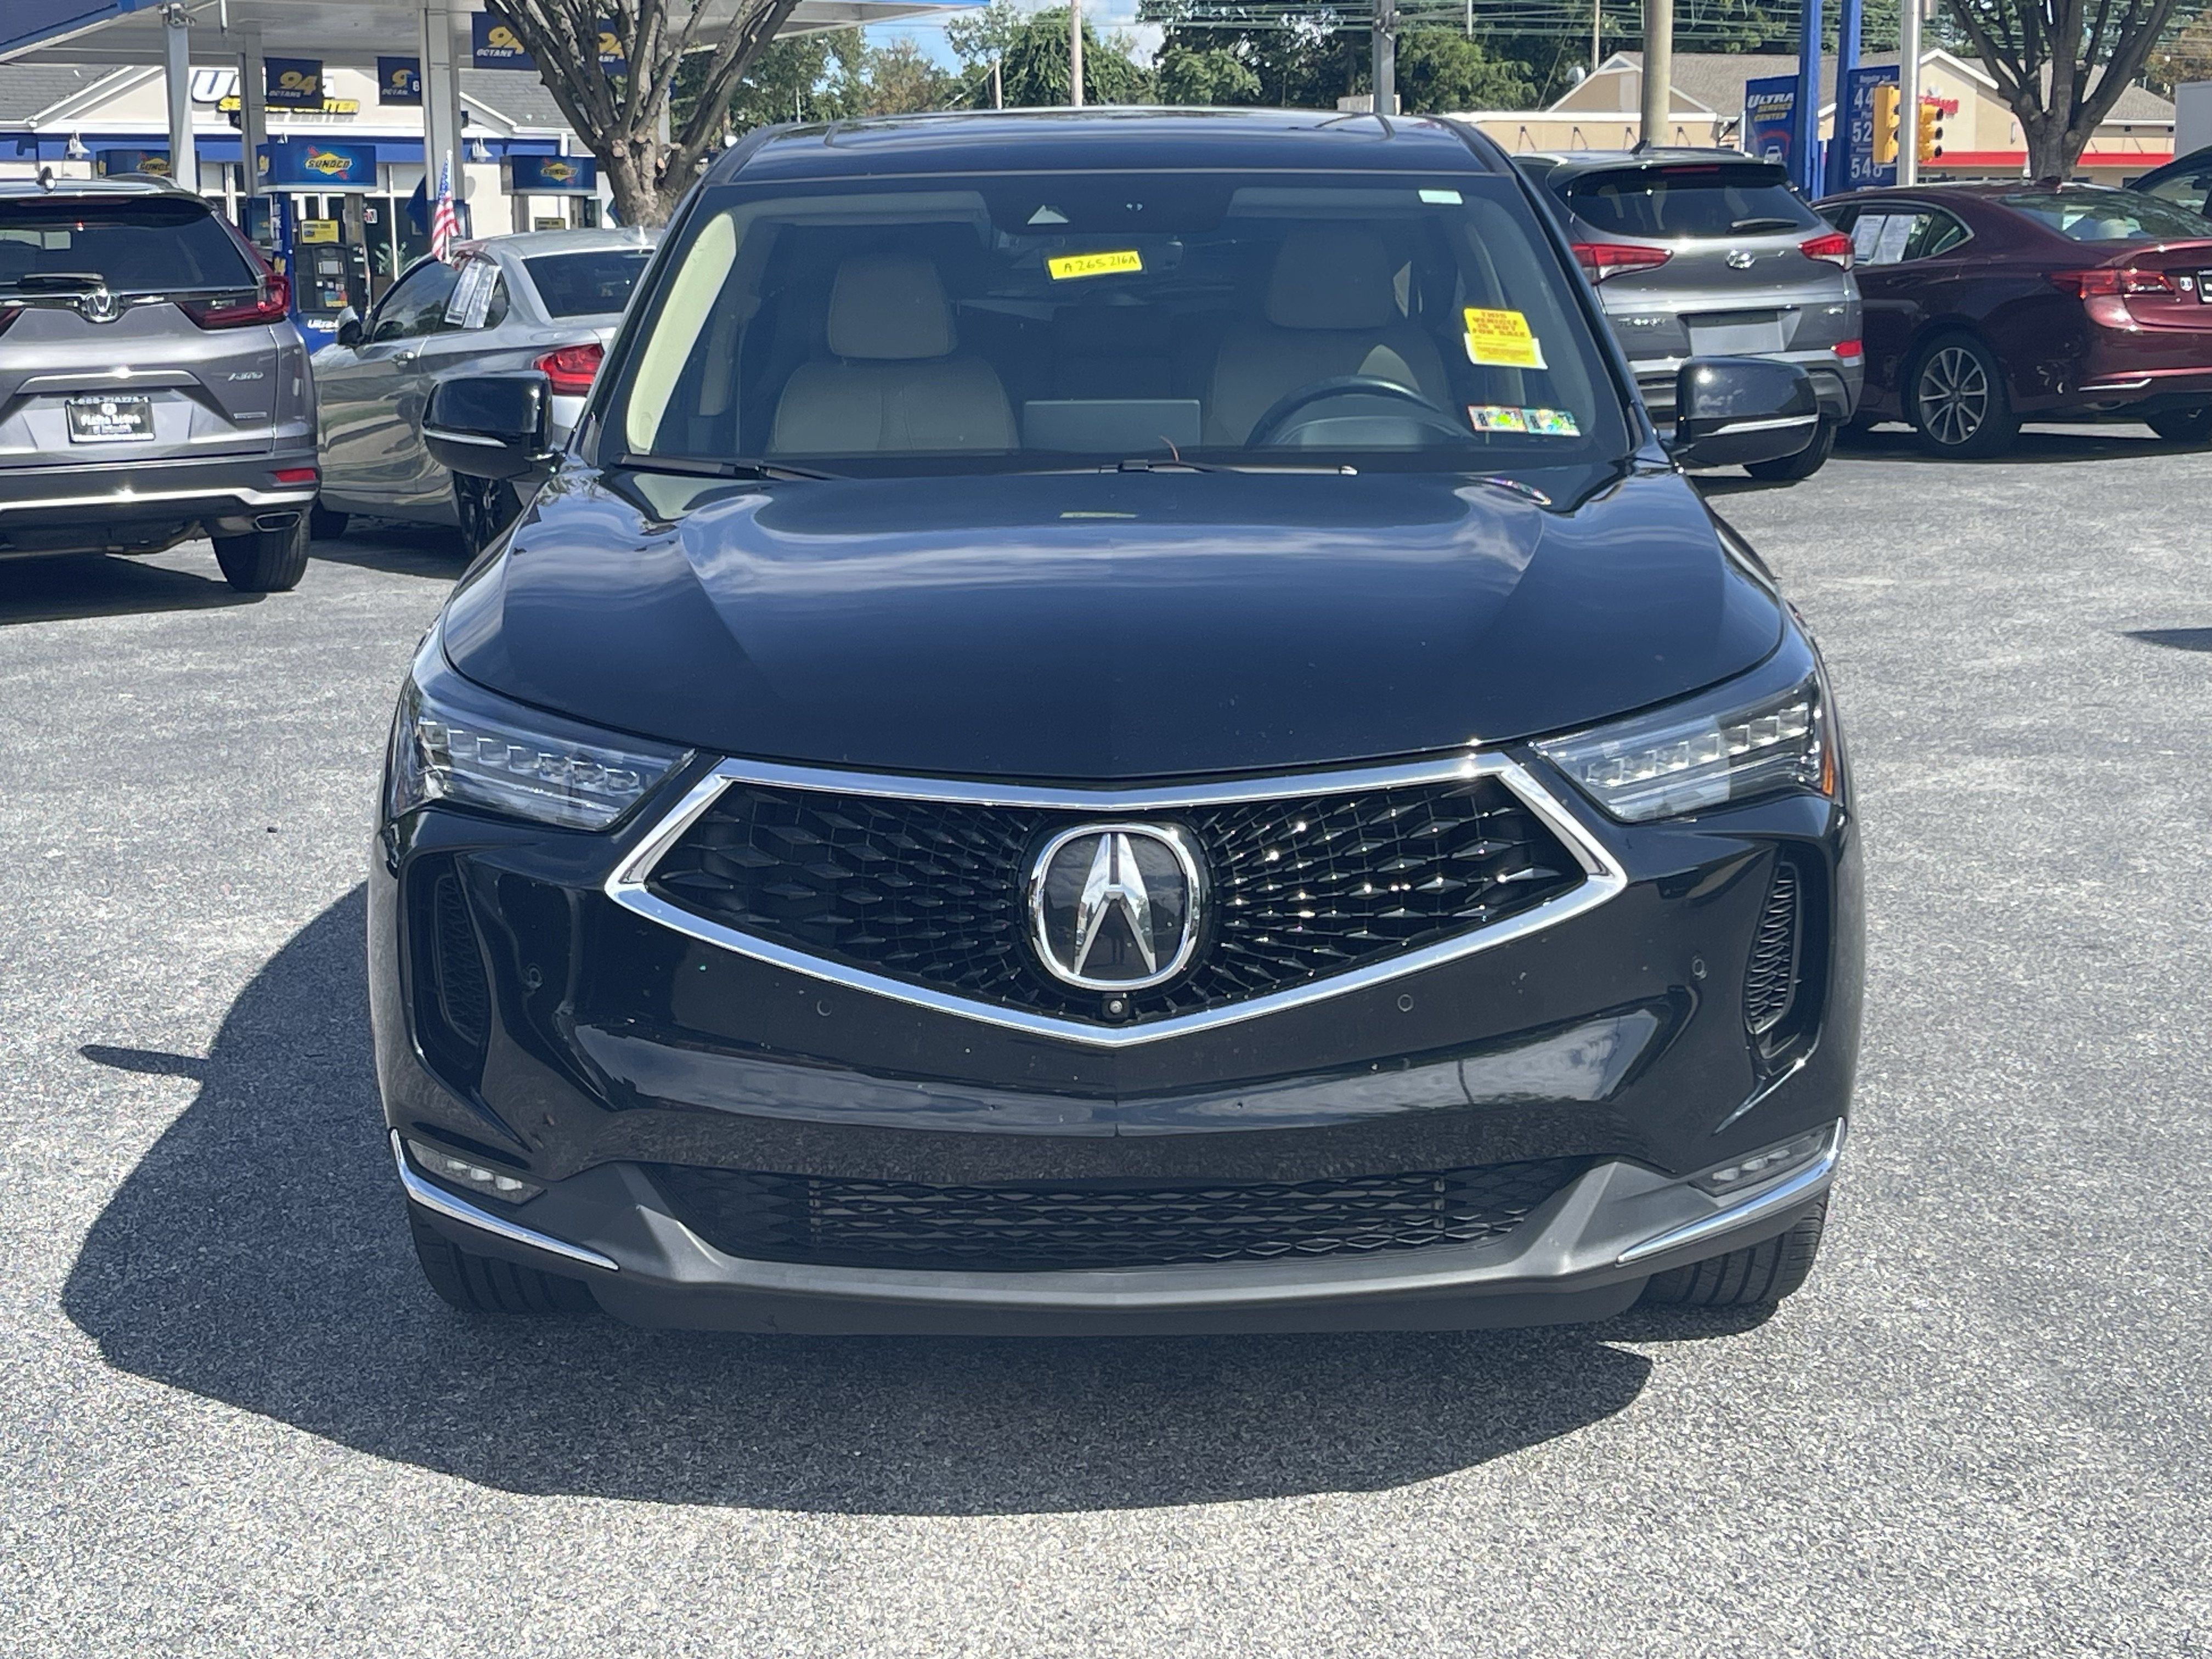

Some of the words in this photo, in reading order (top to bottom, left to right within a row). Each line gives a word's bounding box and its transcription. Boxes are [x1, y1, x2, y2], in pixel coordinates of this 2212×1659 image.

[477, 48, 514, 57] OCTANE
[280, 71, 318, 96] 94
[1747, 93, 1794, 109] ULTRA
[1854, 88, 1875, 109] 44
[1852, 121, 1872, 143] 52
[307, 159, 351, 168] SUNOCO
